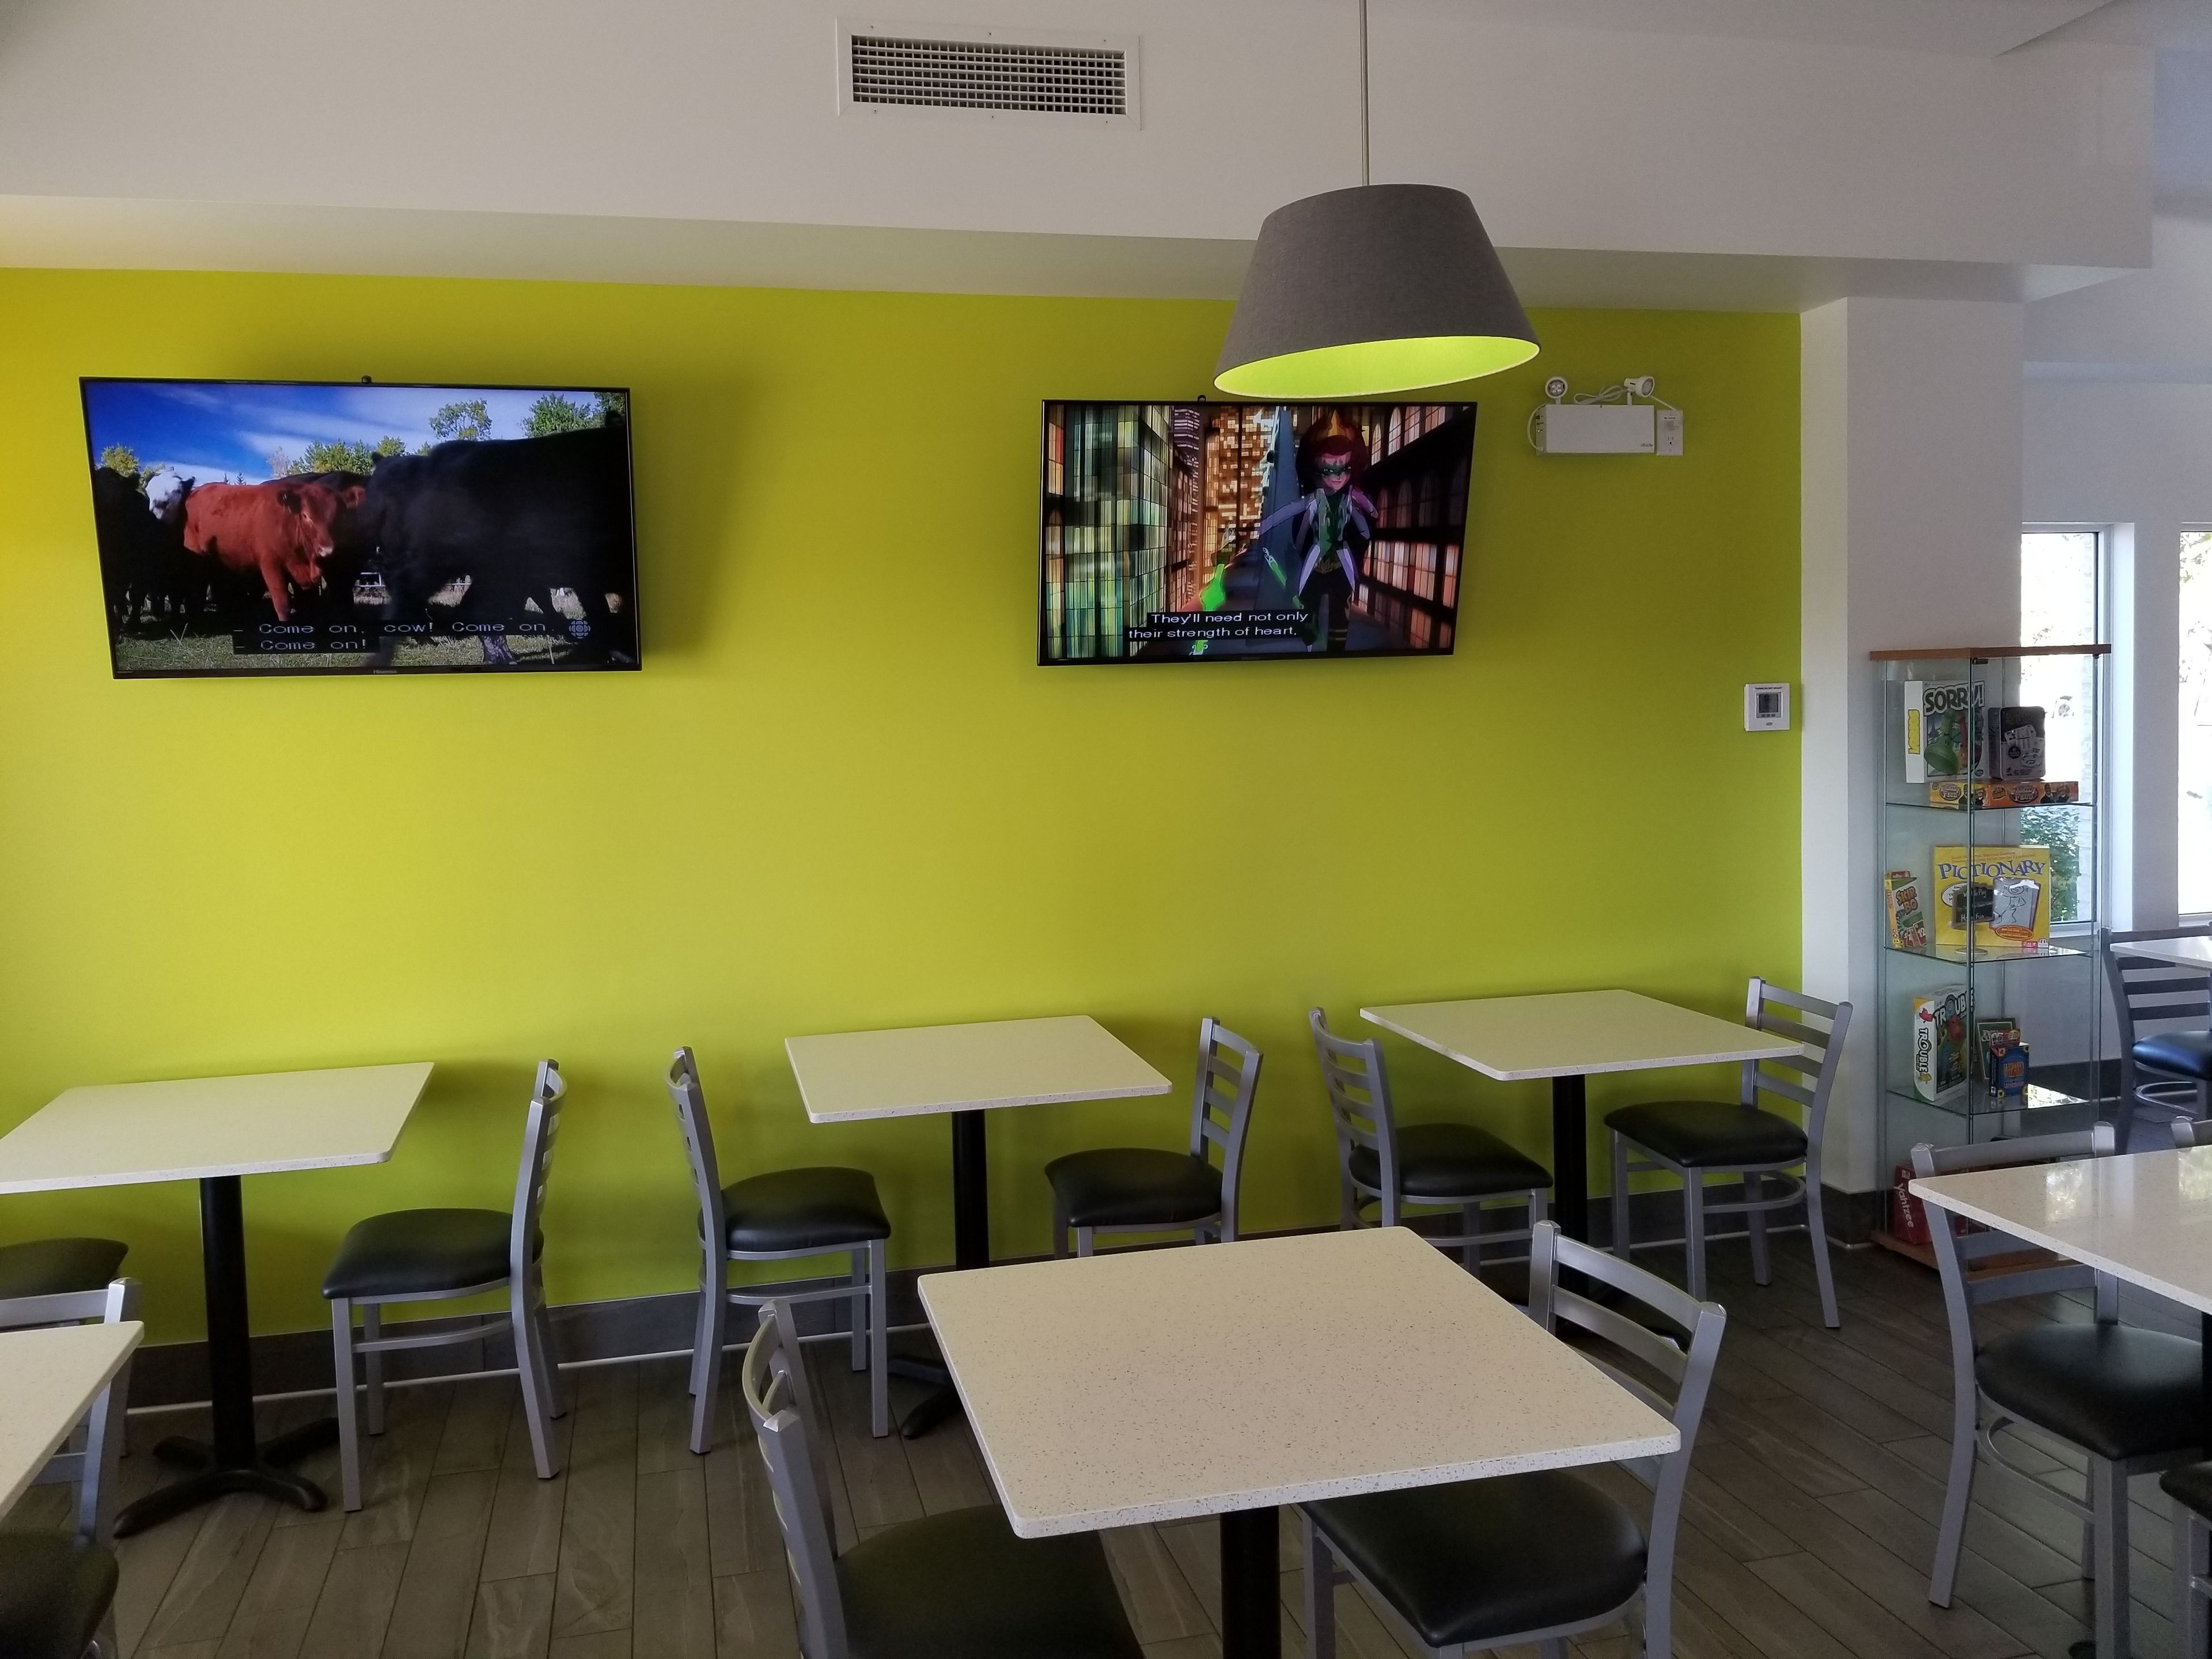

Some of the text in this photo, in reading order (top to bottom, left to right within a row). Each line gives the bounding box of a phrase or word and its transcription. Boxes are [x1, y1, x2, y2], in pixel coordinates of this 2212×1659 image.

[1151, 613, 1199, 625] They'll
[1205, 612, 1242, 623] need
[1277, 611, 1308, 623] only
[259, 623, 314, 634] Come
[384, 622, 433, 632] cow!
[452, 622, 505, 632] Come
[1129, 629, 1163, 639] their
[1167, 627, 1230, 639] strength
[1234, 626, 1250, 637] of
[260, 639, 315, 650] Come
[331, 638, 366, 650] on!
[1937, 859, 2046, 880] PICTIONARY
[1918, 1028, 1930, 1073] TROUBLE
[1894, 1183, 1914, 1228] Yahtzee
